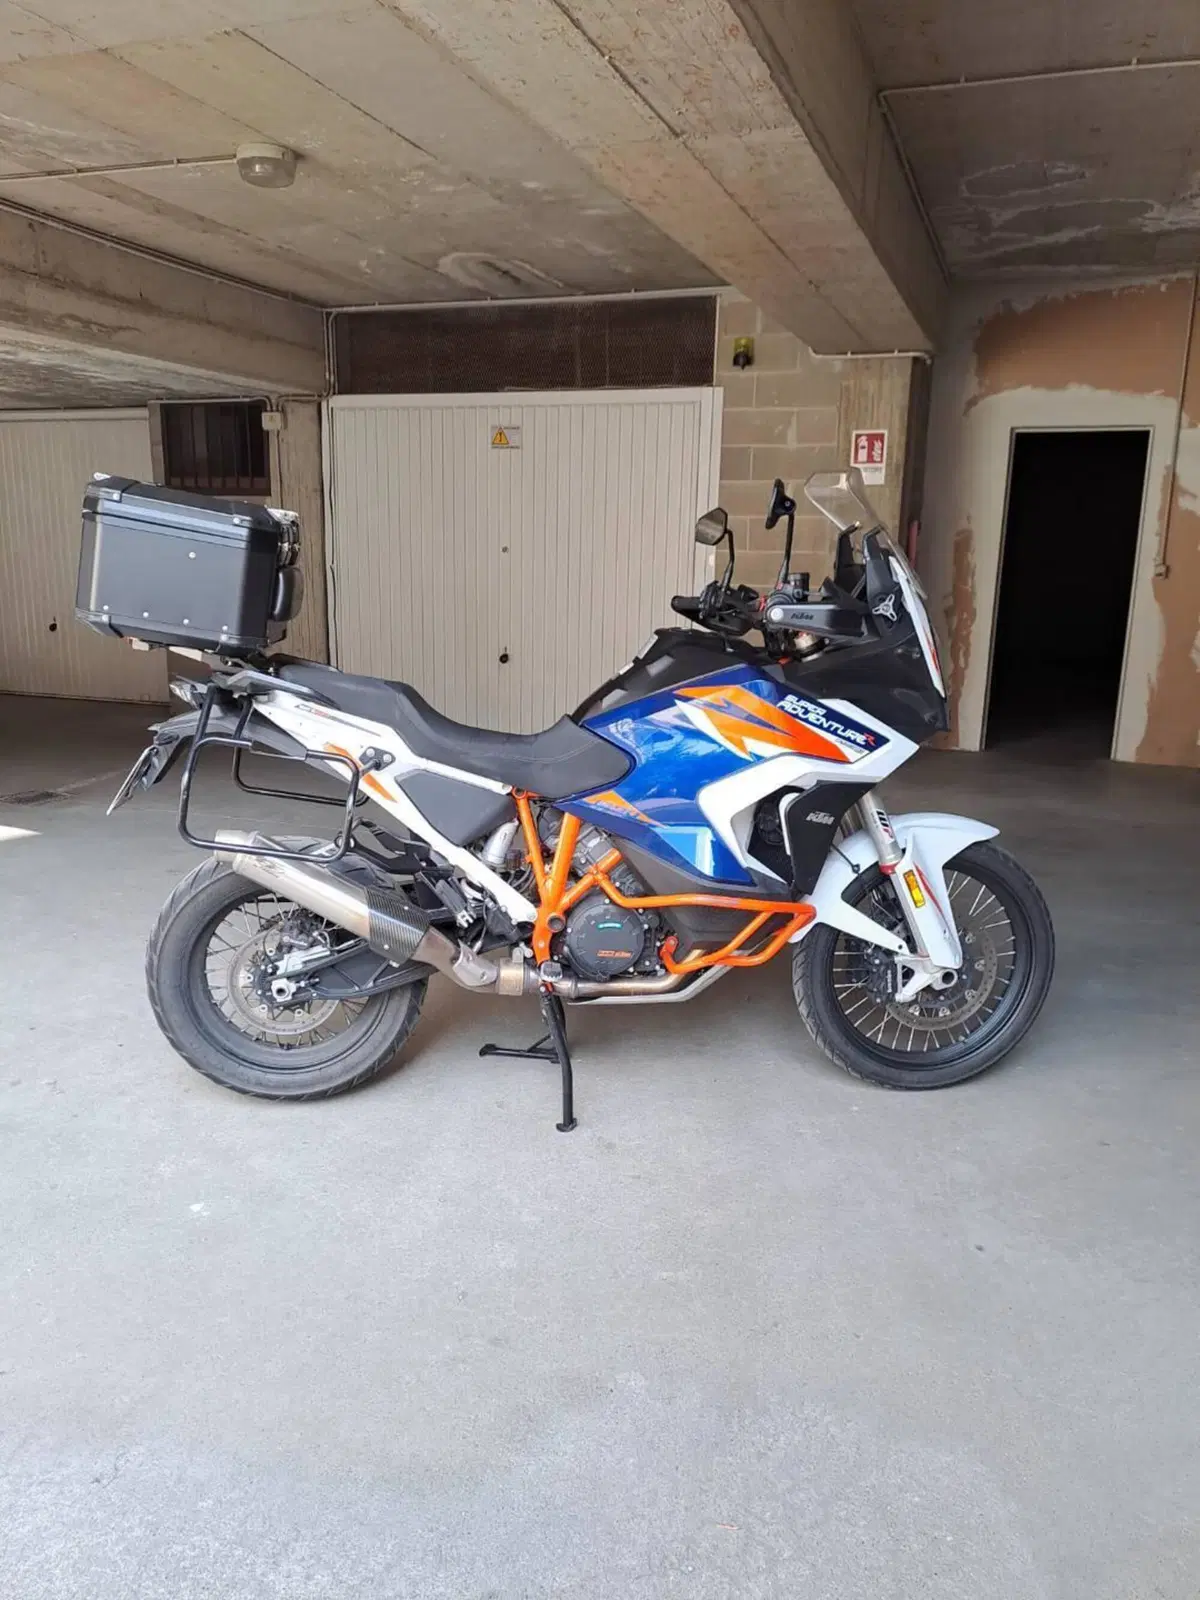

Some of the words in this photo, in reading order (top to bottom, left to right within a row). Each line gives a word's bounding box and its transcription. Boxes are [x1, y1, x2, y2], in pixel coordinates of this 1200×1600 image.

[784, 694, 827, 715] SUPER
[776, 701, 866, 745] ADVENTURE
[806, 811, 836, 825] KTM
